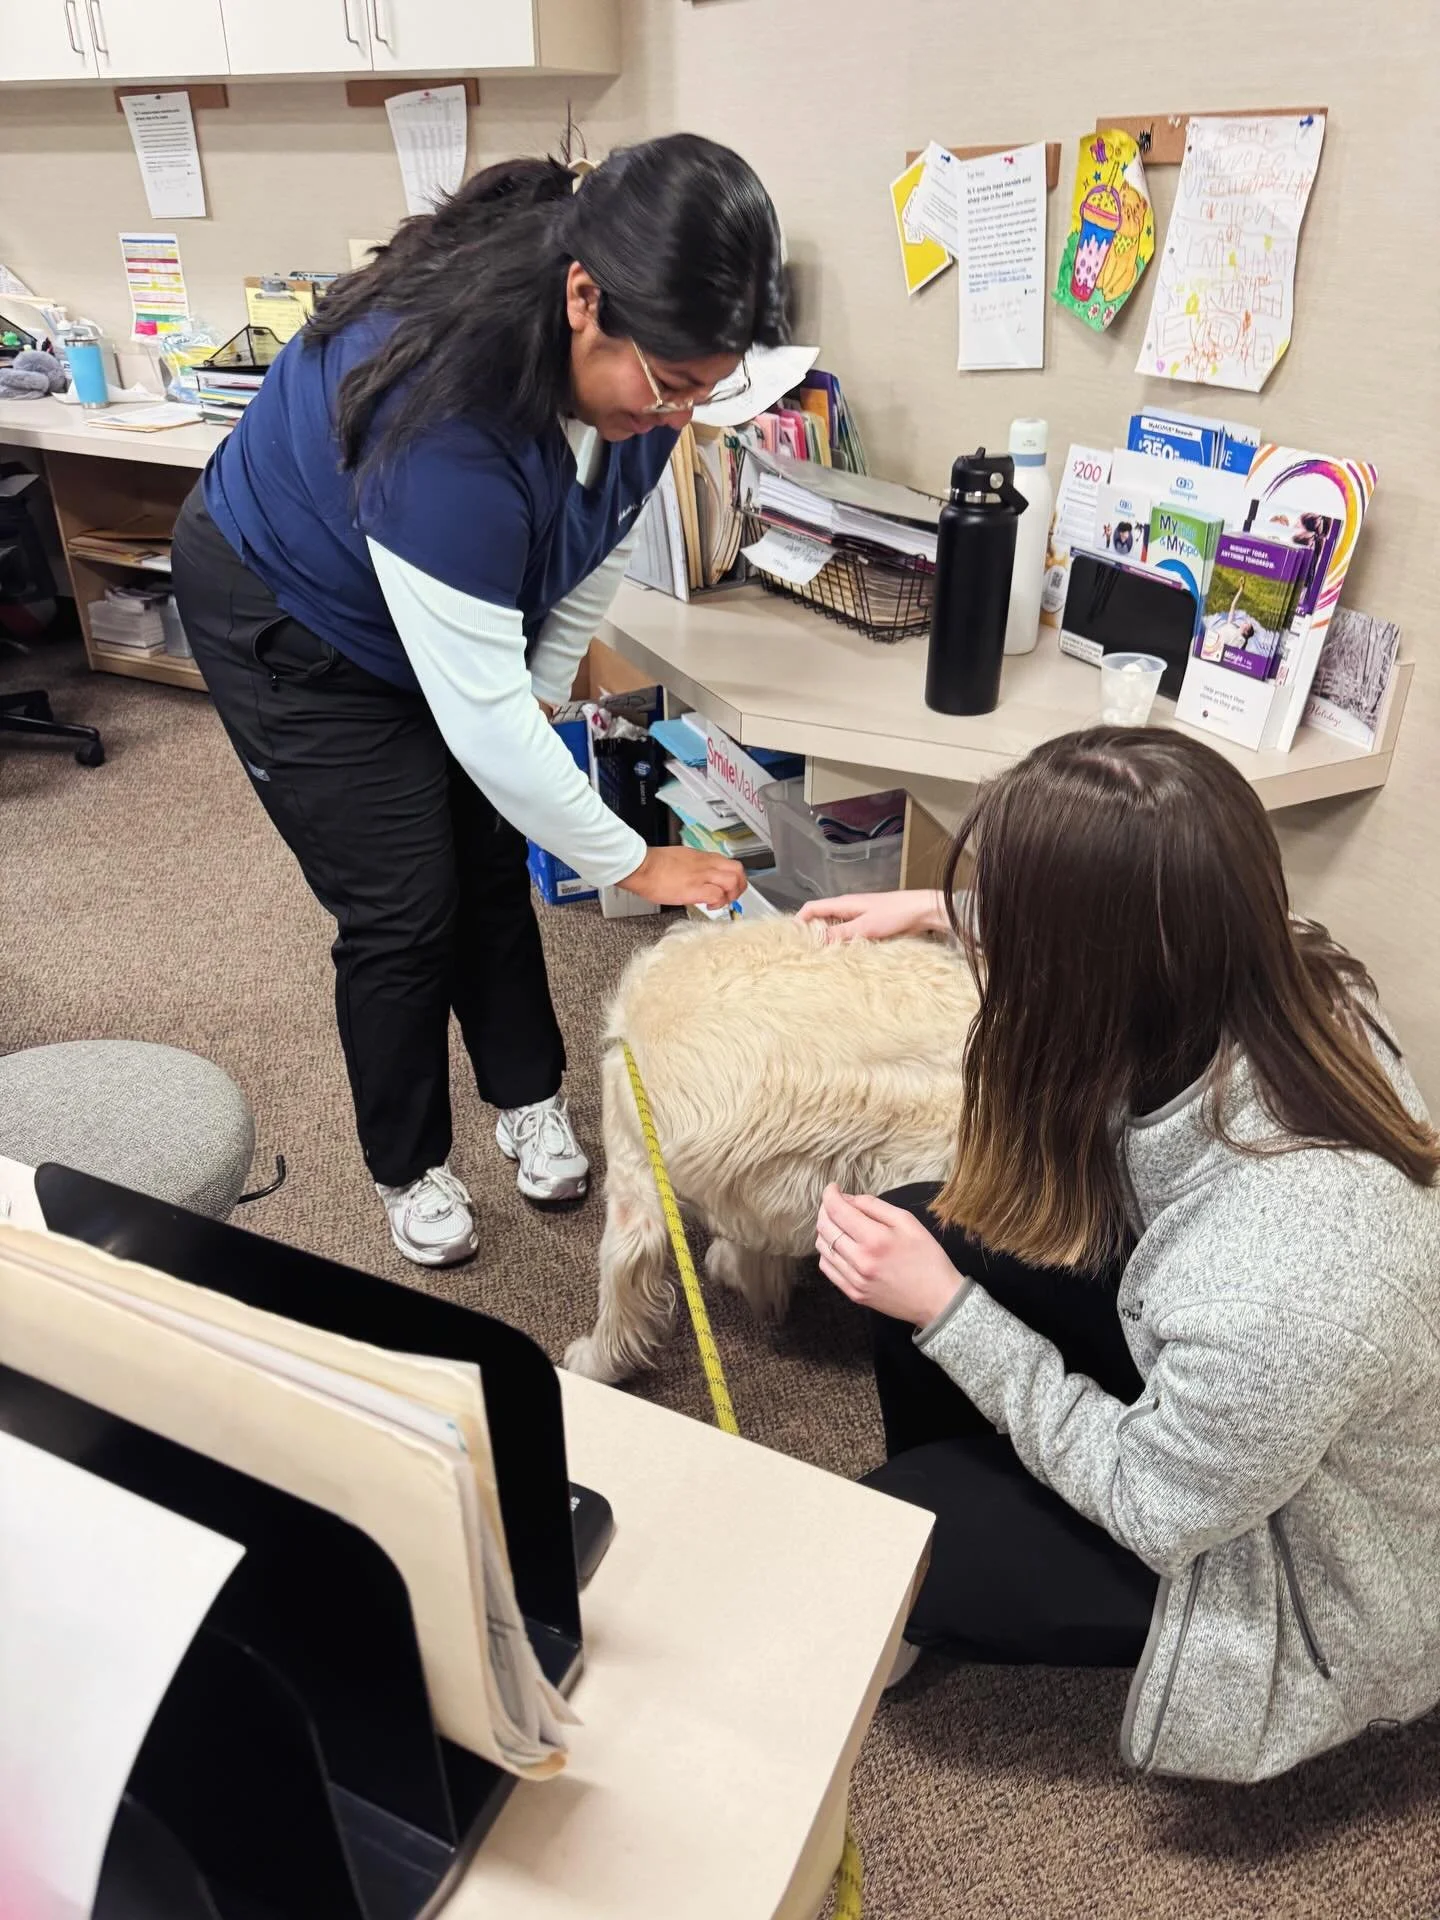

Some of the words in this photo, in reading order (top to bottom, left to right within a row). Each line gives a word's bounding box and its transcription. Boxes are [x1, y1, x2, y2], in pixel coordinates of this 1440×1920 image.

[1073, 460, 1102, 483] $200
[1160, 514, 1178, 534] My
[633, 760, 651, 776] hp
